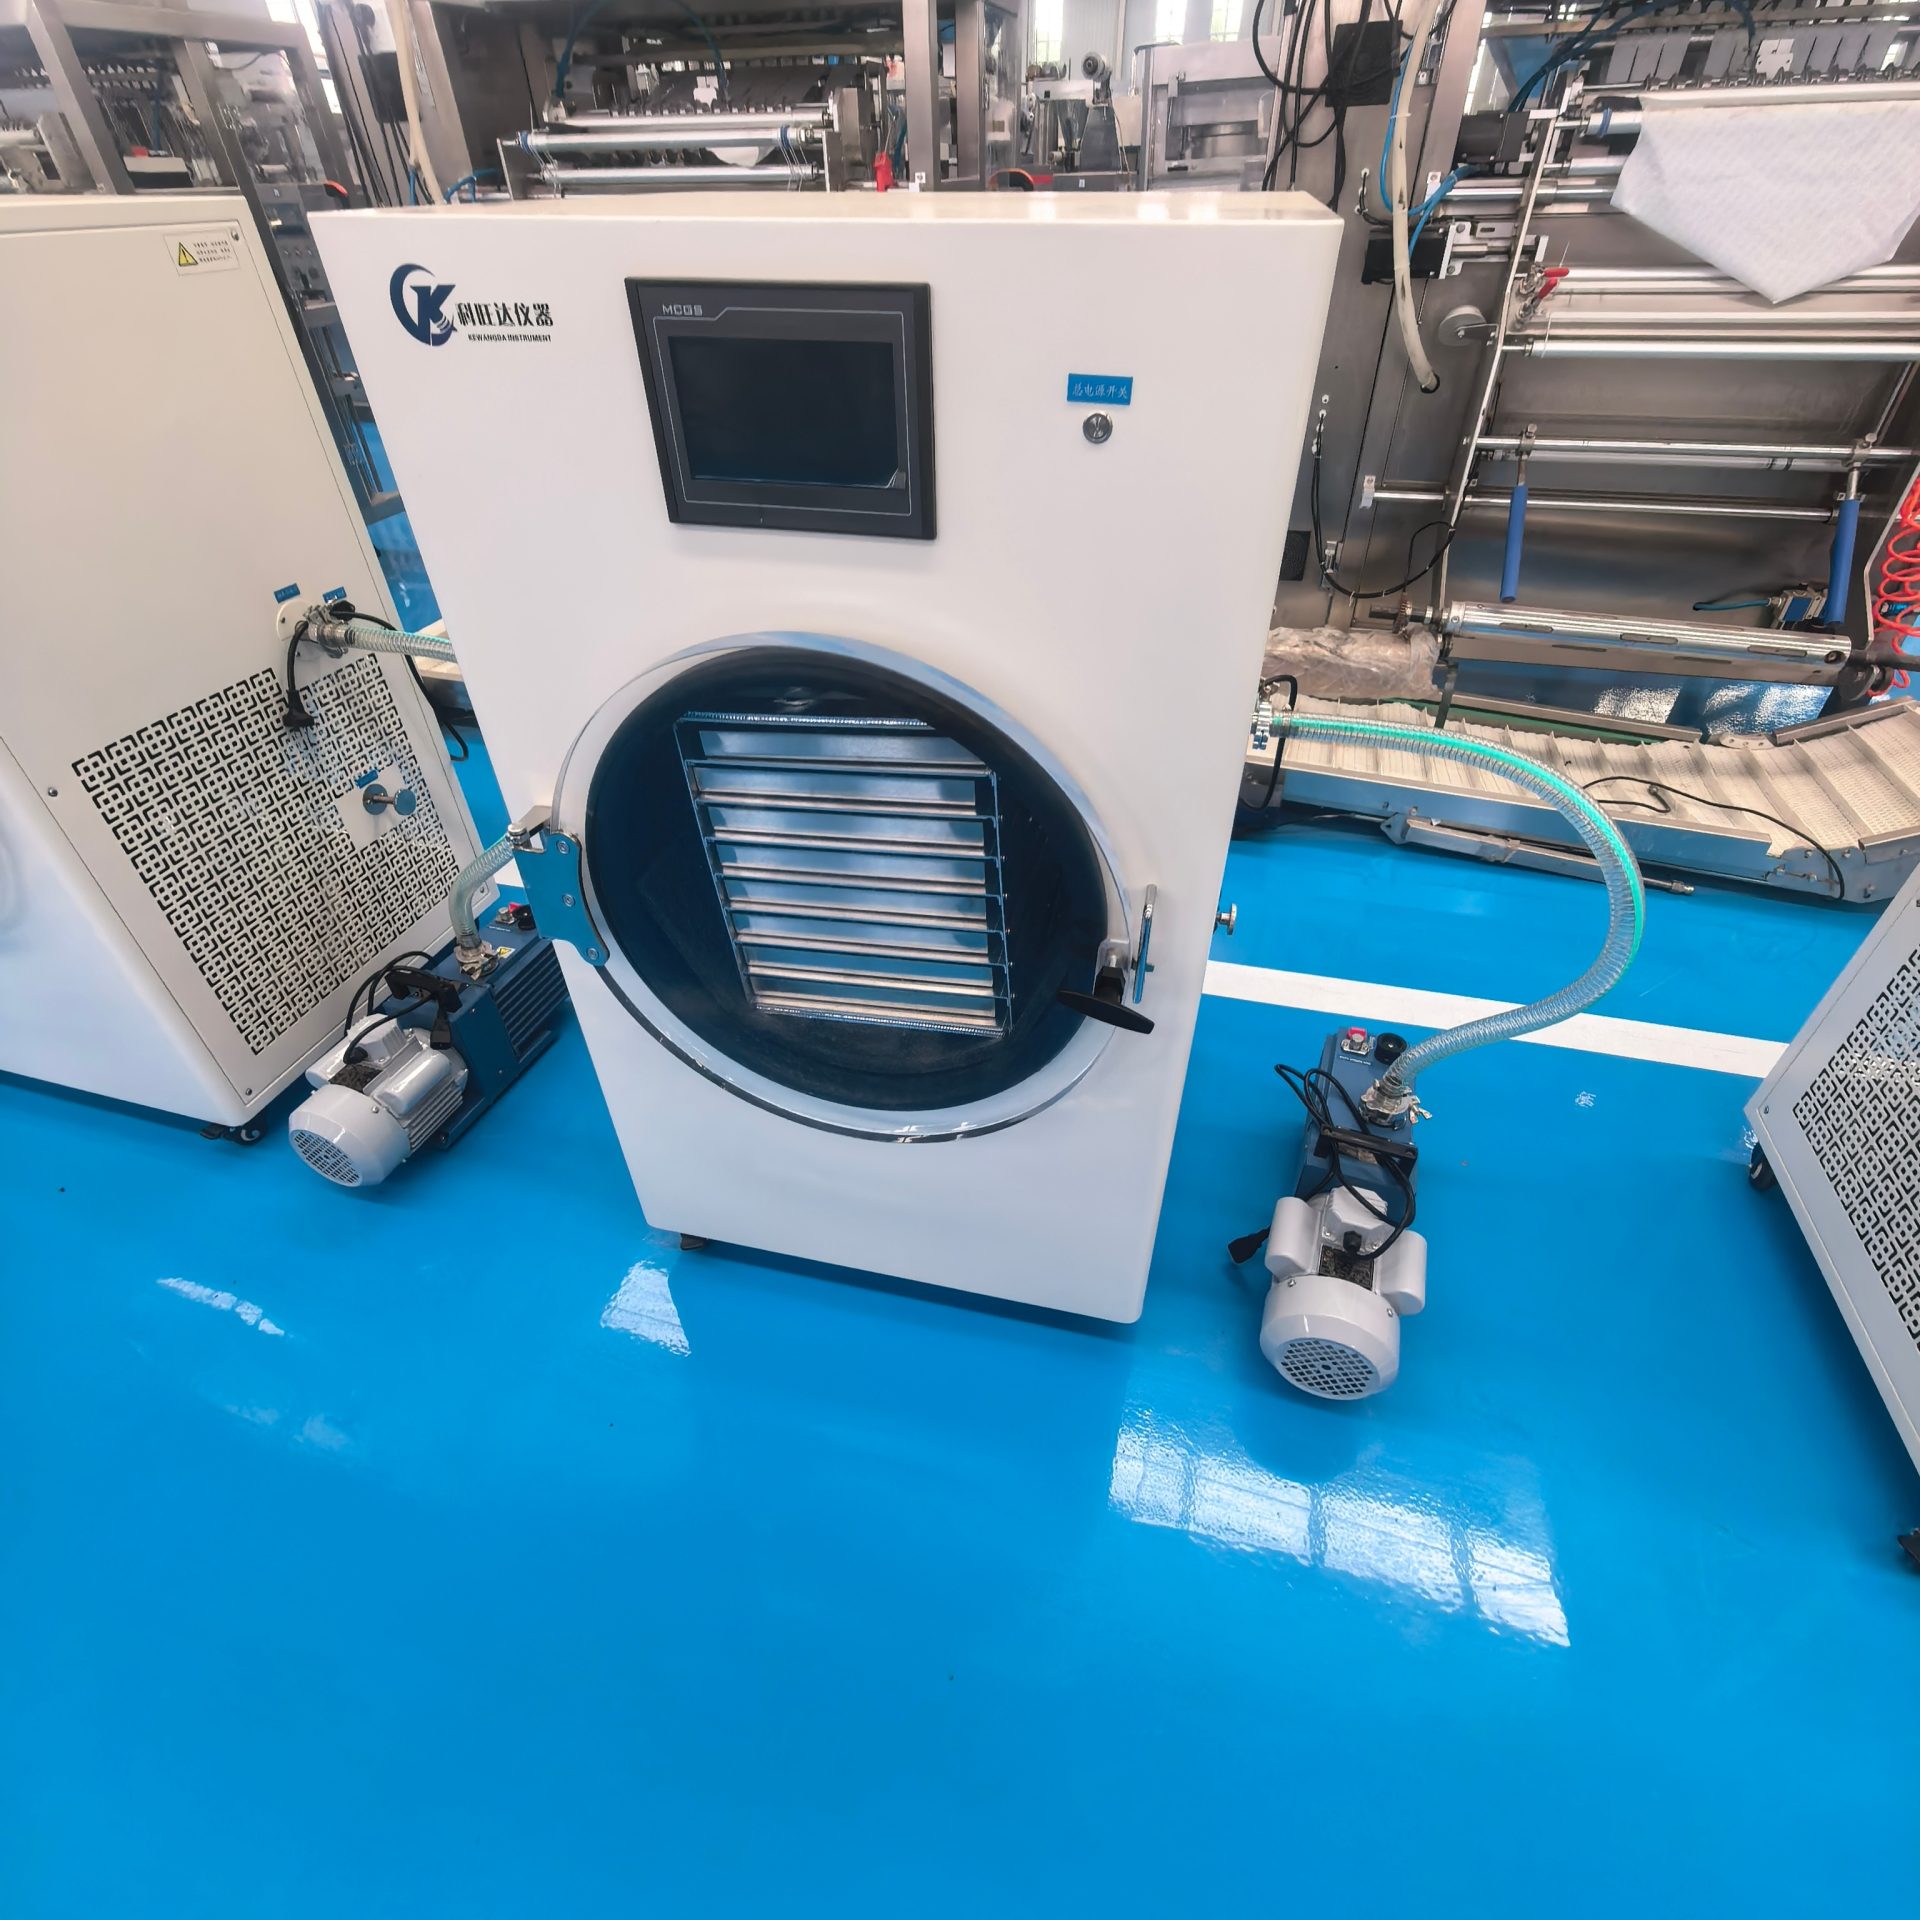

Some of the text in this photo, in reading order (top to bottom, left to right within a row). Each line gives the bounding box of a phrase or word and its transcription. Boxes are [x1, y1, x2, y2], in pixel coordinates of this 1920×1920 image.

[456, 302, 554, 327] 科旺达仪器
[662, 304, 703, 316] MCGS
[468, 333, 552, 342] KEWANGDA INSTRUMENT
[1072, 382, 1128, 399] 总电源开关
